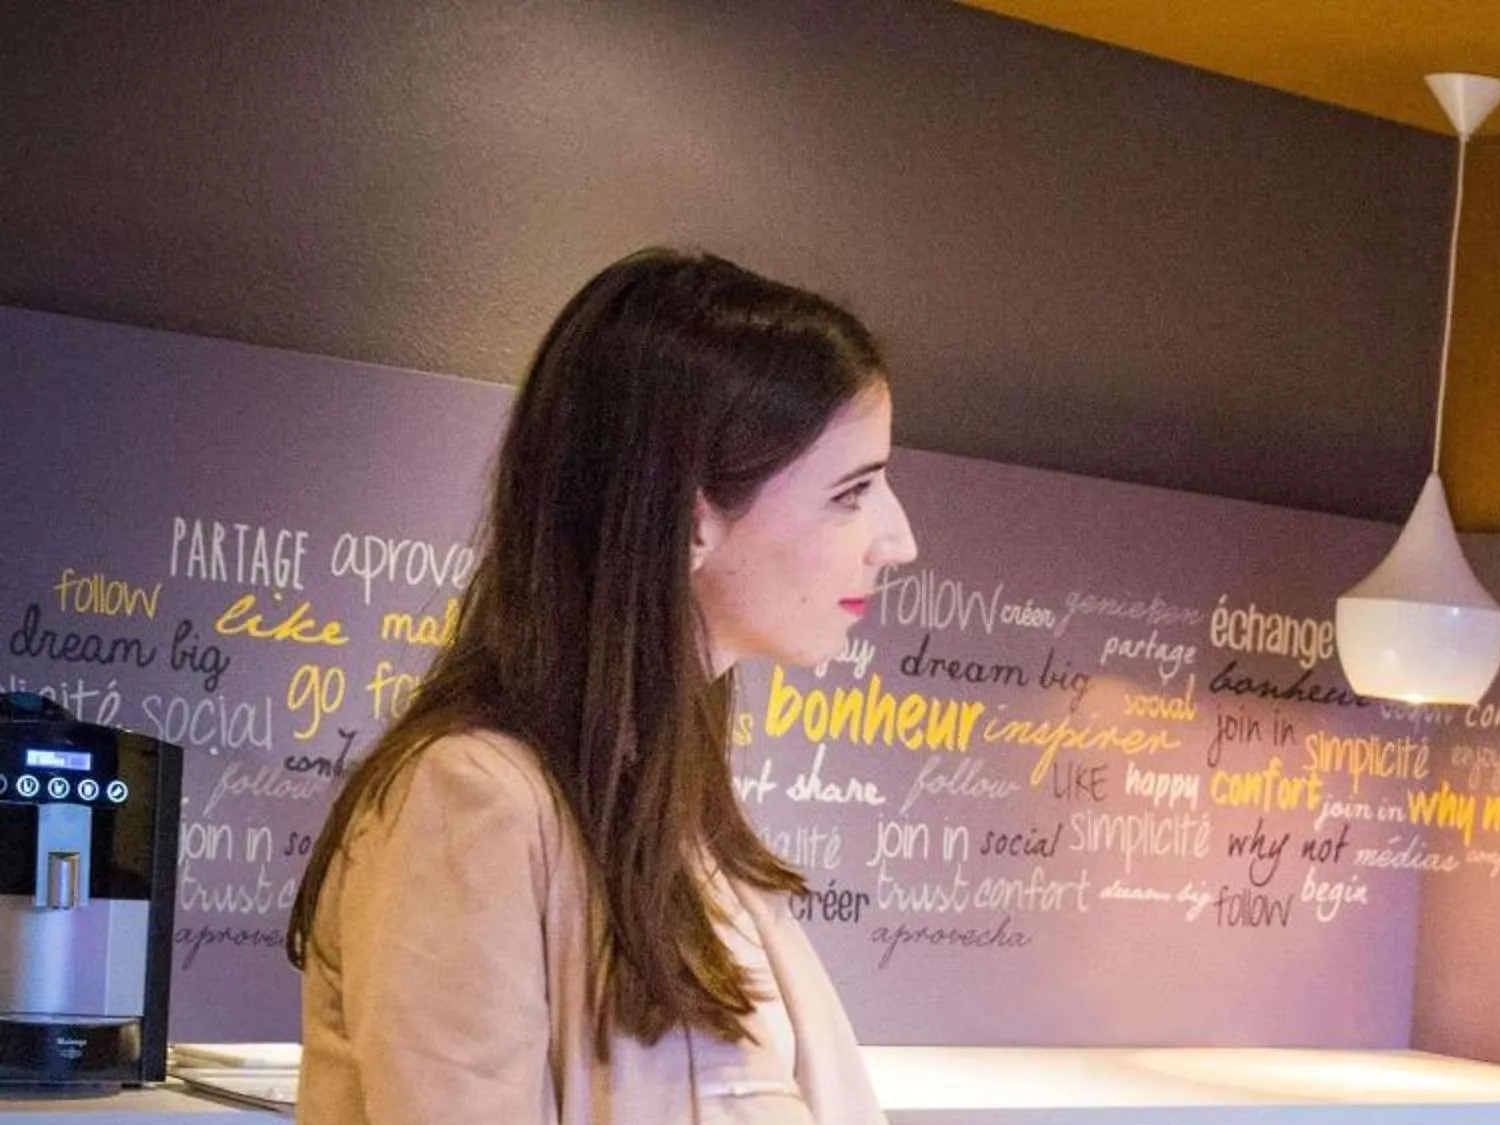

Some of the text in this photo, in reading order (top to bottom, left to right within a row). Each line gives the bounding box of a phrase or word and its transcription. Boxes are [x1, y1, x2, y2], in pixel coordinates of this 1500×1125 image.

[170, 516, 310, 591] PARTAGE
[332, 533, 475, 605] aprove
[54, 568, 162, 619] follow
[215, 592, 349, 645] like
[876, 565, 1004, 634] follow
[1000, 599, 1056, 629] créer
[9, 603, 230, 692] dream big
[1101, 629, 1197, 686] partage
[1210, 594, 1334, 670] échange
[287, 665, 345, 739] go
[901, 635, 1029, 687] dream
[1039, 647, 1092, 713] big
[142, 694, 272, 750] social
[766, 664, 986, 752] bonheur
[1207, 703, 1298, 768] join in
[983, 704, 1181, 785] inspirer
[786, 743, 886, 805] share
[1052, 764, 1108, 802] LIKE
[1125, 761, 1199, 810] happy
[178, 814, 232, 864] join
[247, 824, 273, 862] in
[866, 813, 970, 867] join in
[980, 822, 1064, 858] social
[1314, 793, 1408, 830] join in
[1407, 780, 1476, 847] why
[1068, 808, 1211, 875] simplicité
[1228, 818, 1349, 887] why not
[179, 860, 273, 914] trust
[789, 880, 870, 924] créer
[877, 858, 1091, 914] trust confort
[1213, 885, 1294, 928] follow
[1300, 866, 1368, 923] begin
